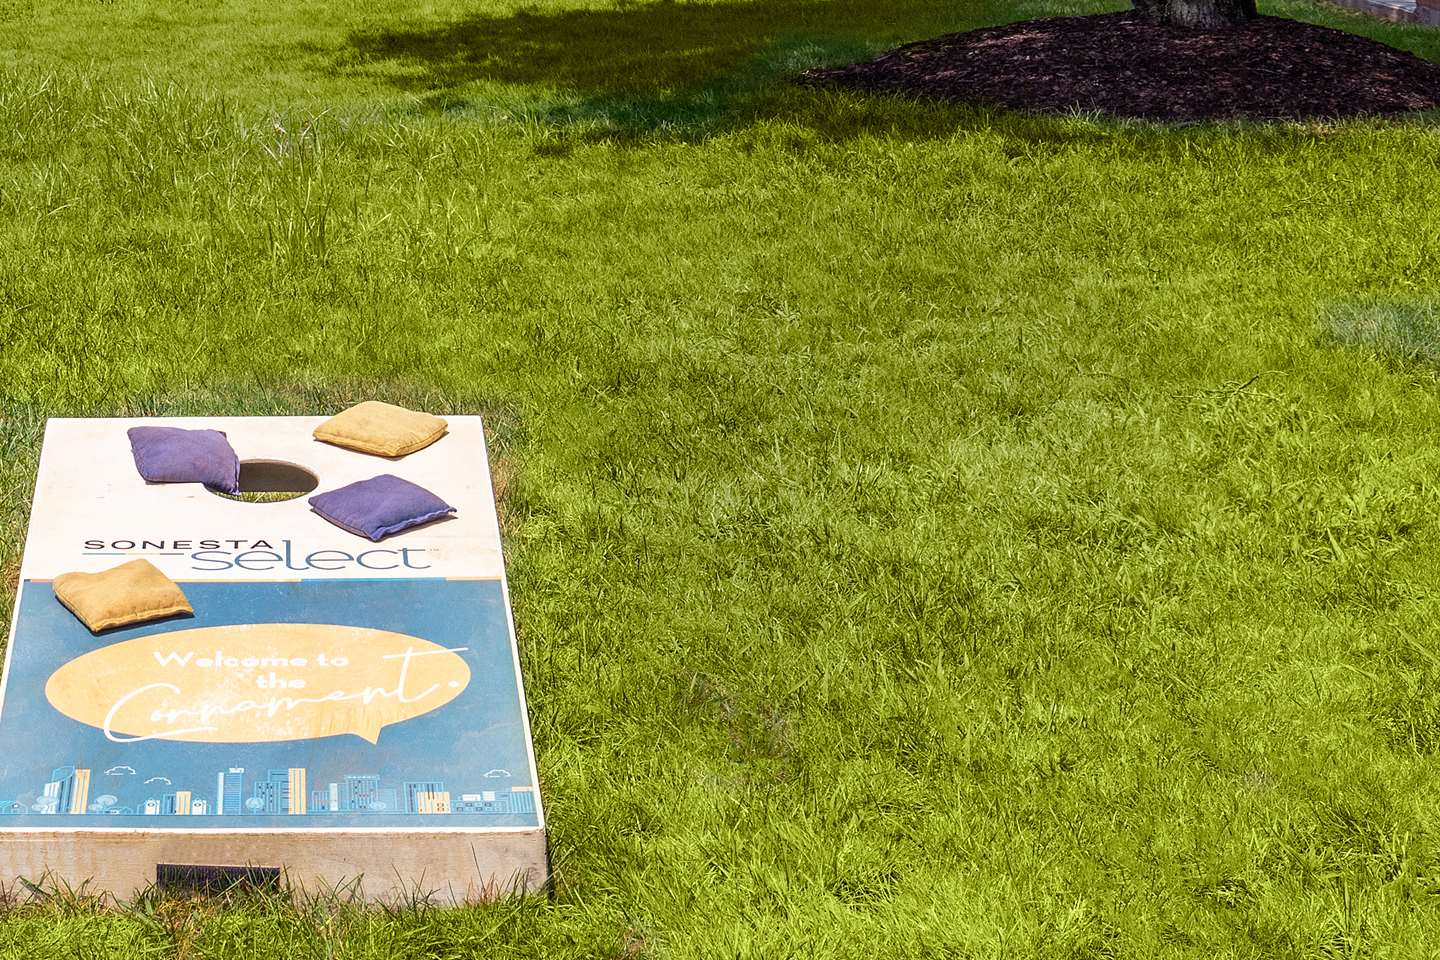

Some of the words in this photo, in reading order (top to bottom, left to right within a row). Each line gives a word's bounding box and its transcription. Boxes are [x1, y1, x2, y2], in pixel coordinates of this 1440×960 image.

[83, 539, 274, 551] SONESTA
[191, 539, 432, 571] select
[153, 649, 308, 668] Welcome
[317, 651, 350, 667] to
[256, 671, 306, 690] the
